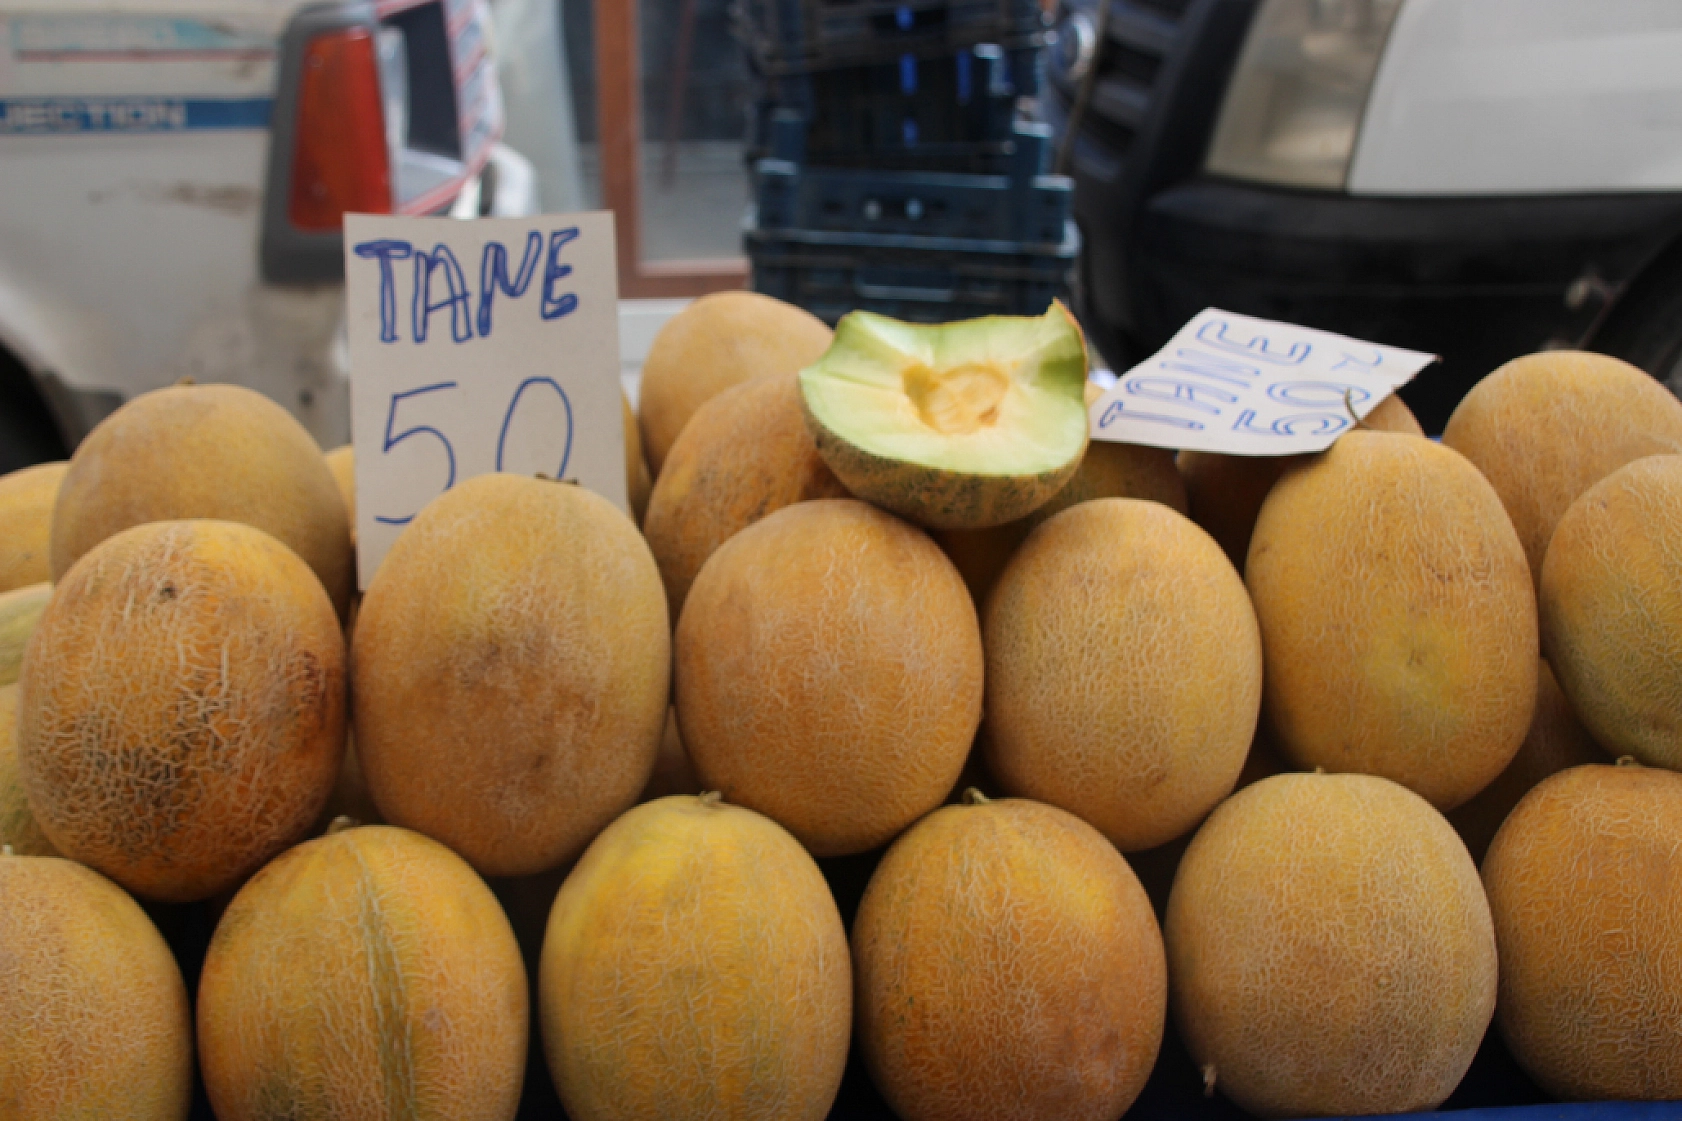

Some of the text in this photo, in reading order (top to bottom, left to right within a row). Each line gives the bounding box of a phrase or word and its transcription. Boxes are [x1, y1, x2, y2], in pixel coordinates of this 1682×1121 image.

[354, 226, 580, 345] TANE
[1098, 318, 1313, 431] TANE
[374, 375, 575, 525] 50
